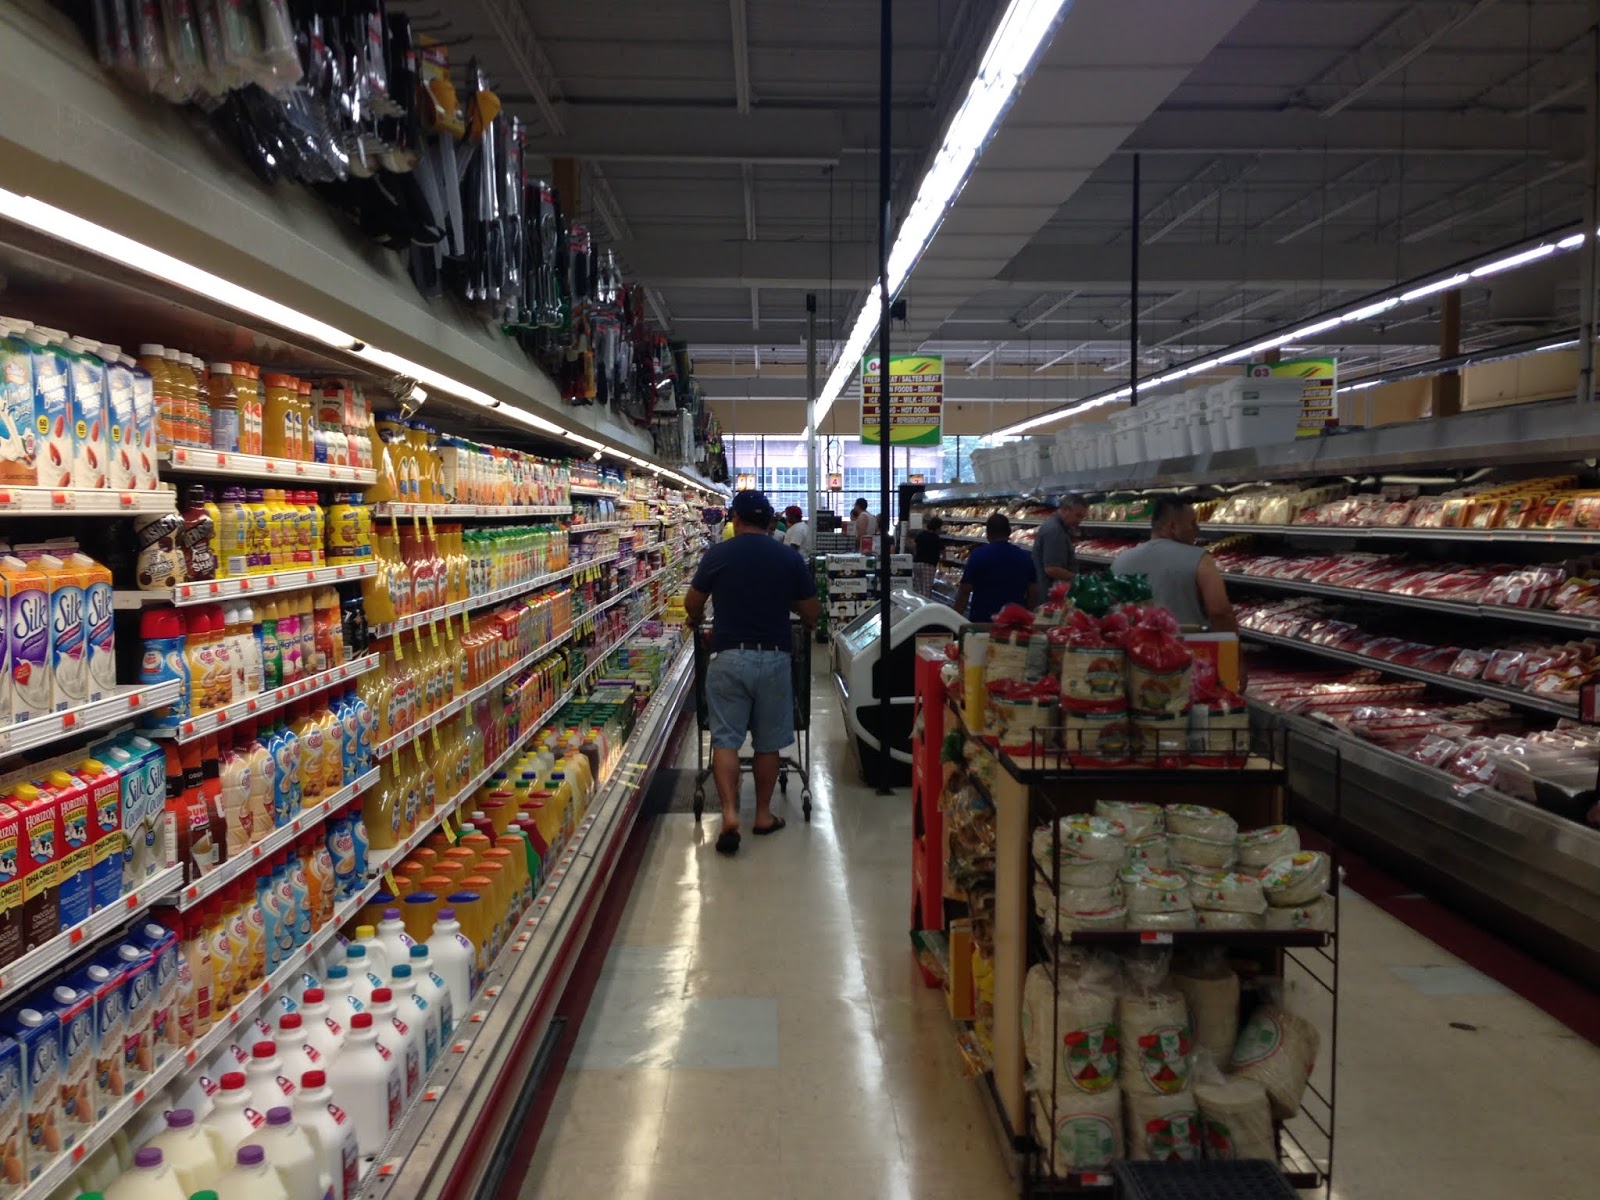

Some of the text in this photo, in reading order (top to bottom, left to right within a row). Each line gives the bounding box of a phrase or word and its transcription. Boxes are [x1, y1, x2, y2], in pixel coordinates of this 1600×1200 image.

[1254, 368, 1270, 378] 03
[13, 596, 47, 640] Silk
[54, 592, 83, 633] Silk
[88, 588, 113, 627] Silk
[93, 780, 119, 801] HORIZON
[146, 762, 166, 795] Silk
[125, 774, 145, 809] Silk
[60, 792, 89, 816] HORIZON
[25, 806, 56, 830] HORIZON
[61, 856, 73, 869] DHA
[26, 873, 40, 887] DHA
